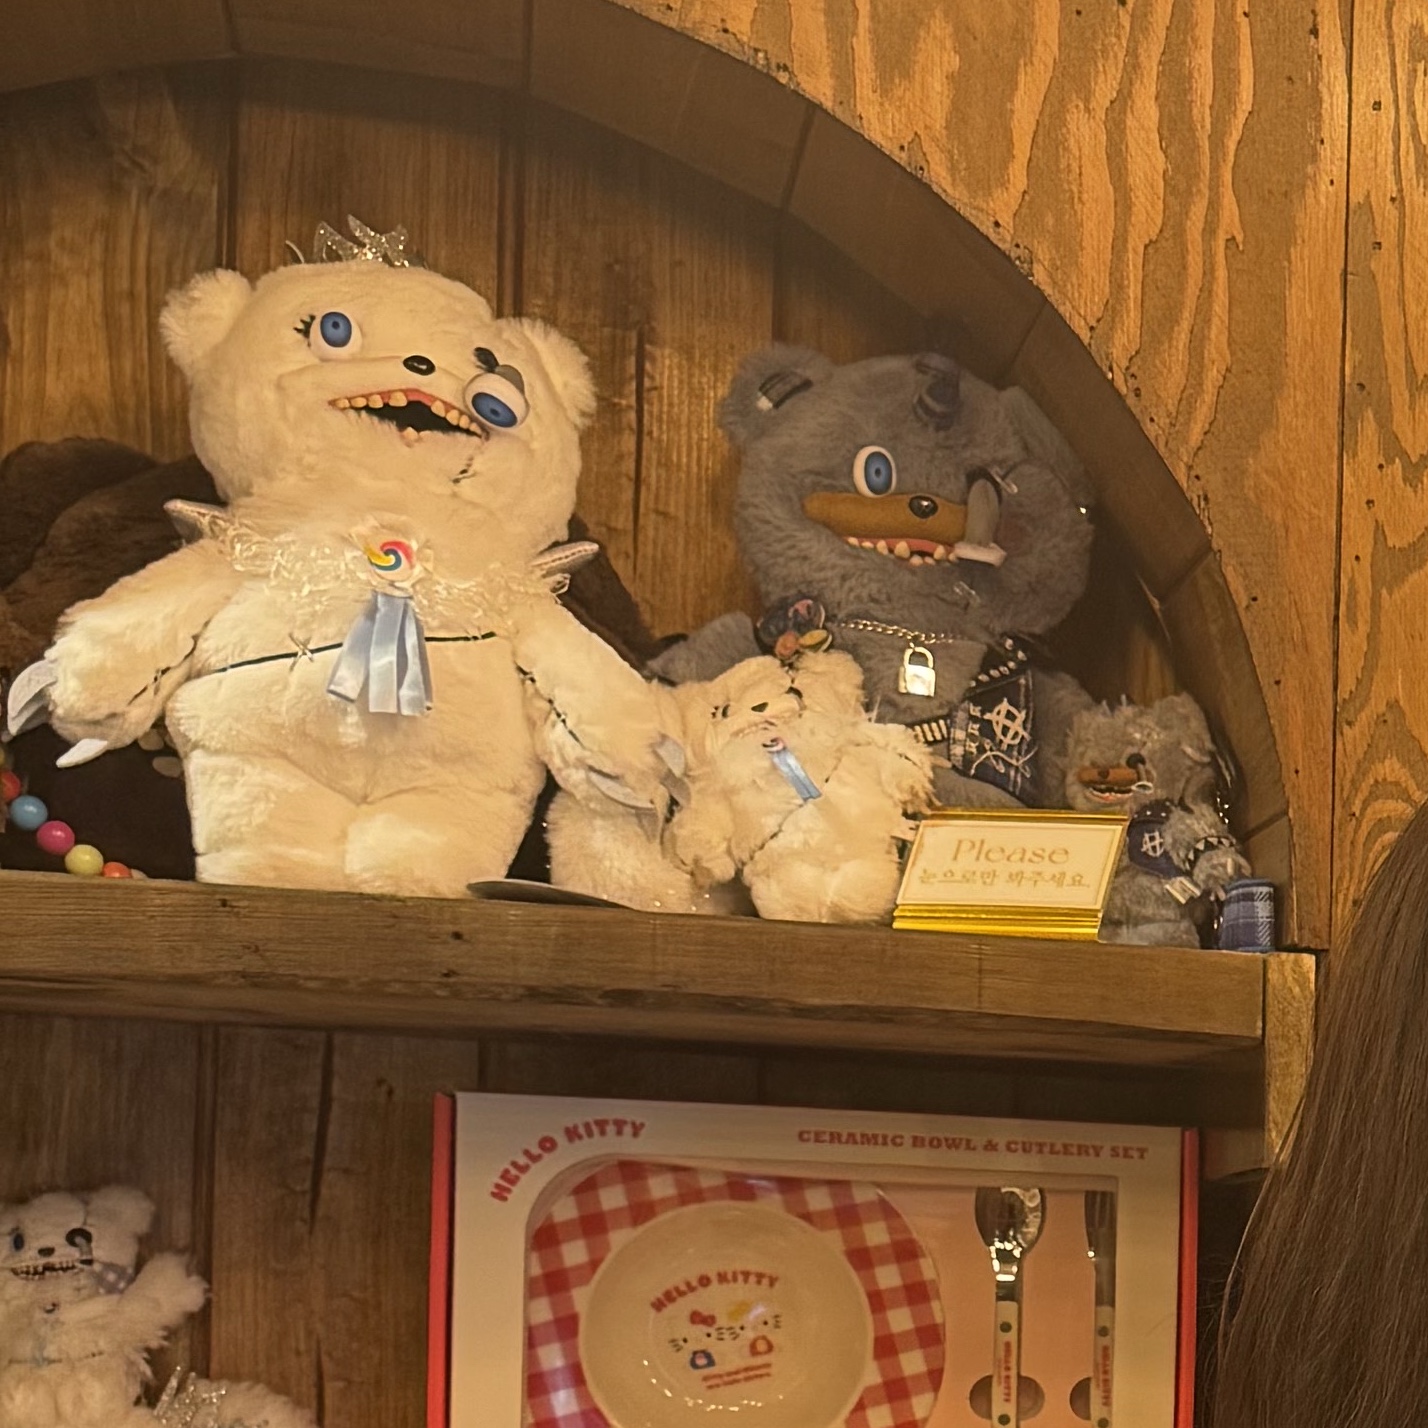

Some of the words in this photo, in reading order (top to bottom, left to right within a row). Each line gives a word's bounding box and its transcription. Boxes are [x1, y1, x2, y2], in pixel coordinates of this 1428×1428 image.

[950, 838, 1071, 866] Please
[490, 1134, 559, 1203] HELLO
[563, 1117, 647, 1145] KITTY
[797, 1128, 906, 1149] CERAMIC
[911, 1134, 978, 1153] BOWL
[982, 1138, 1000, 1154] &
[1004, 1139, 1106, 1160] CUTLERY
[1110, 1145, 1150, 1160] SET
[649, 1274, 714, 1314] HELLO
[715, 1270, 780, 1289] KITTY
